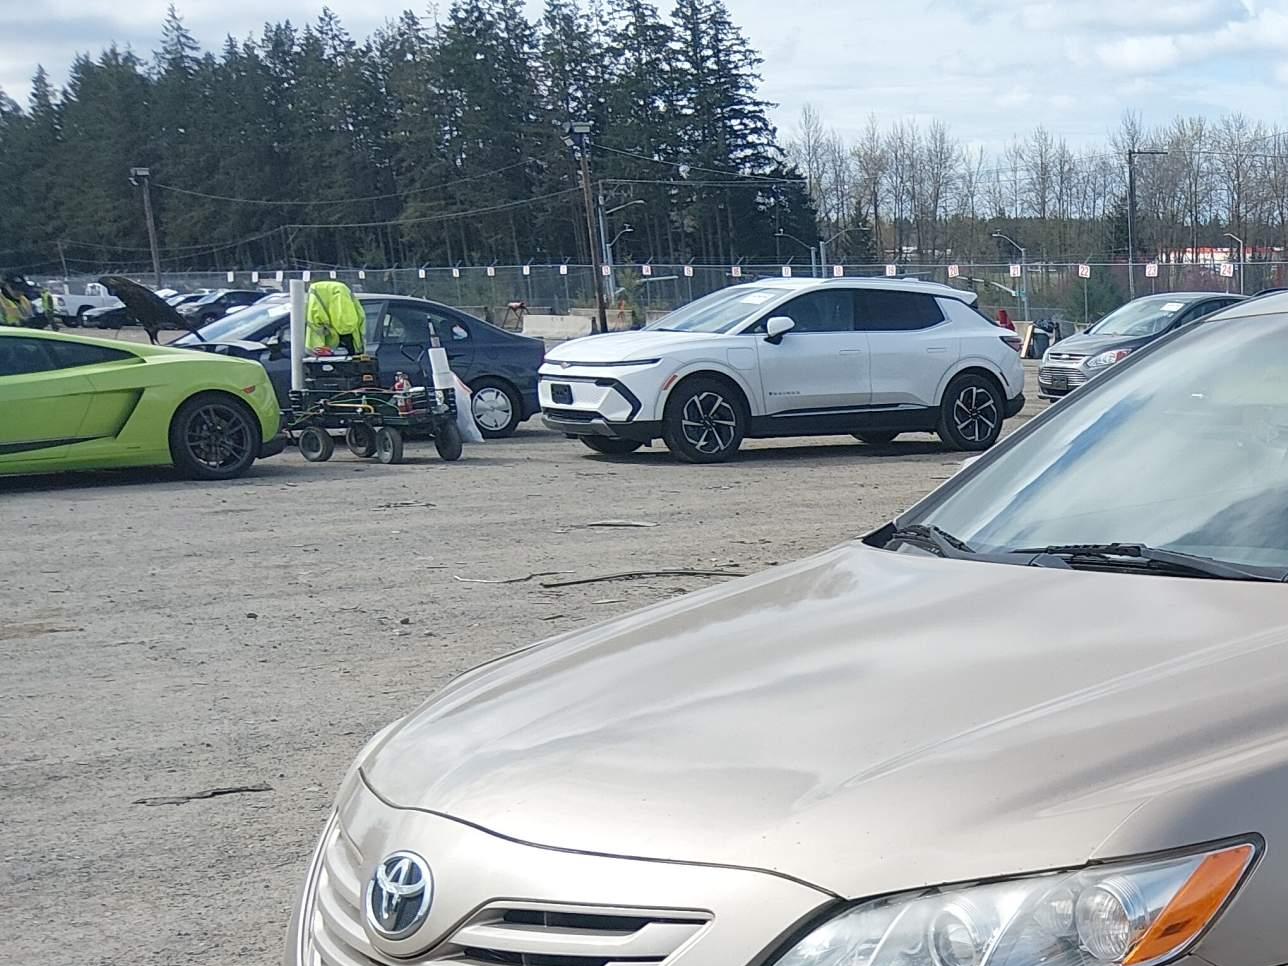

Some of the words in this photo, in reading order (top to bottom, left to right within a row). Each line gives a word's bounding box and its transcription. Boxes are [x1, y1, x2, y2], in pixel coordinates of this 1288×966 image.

[1012, 267, 1020, 276] 21
[1080, 266, 1089, 277] 22
[1147, 265, 1156, 276] 23
[1222, 265, 1232, 276] 24
